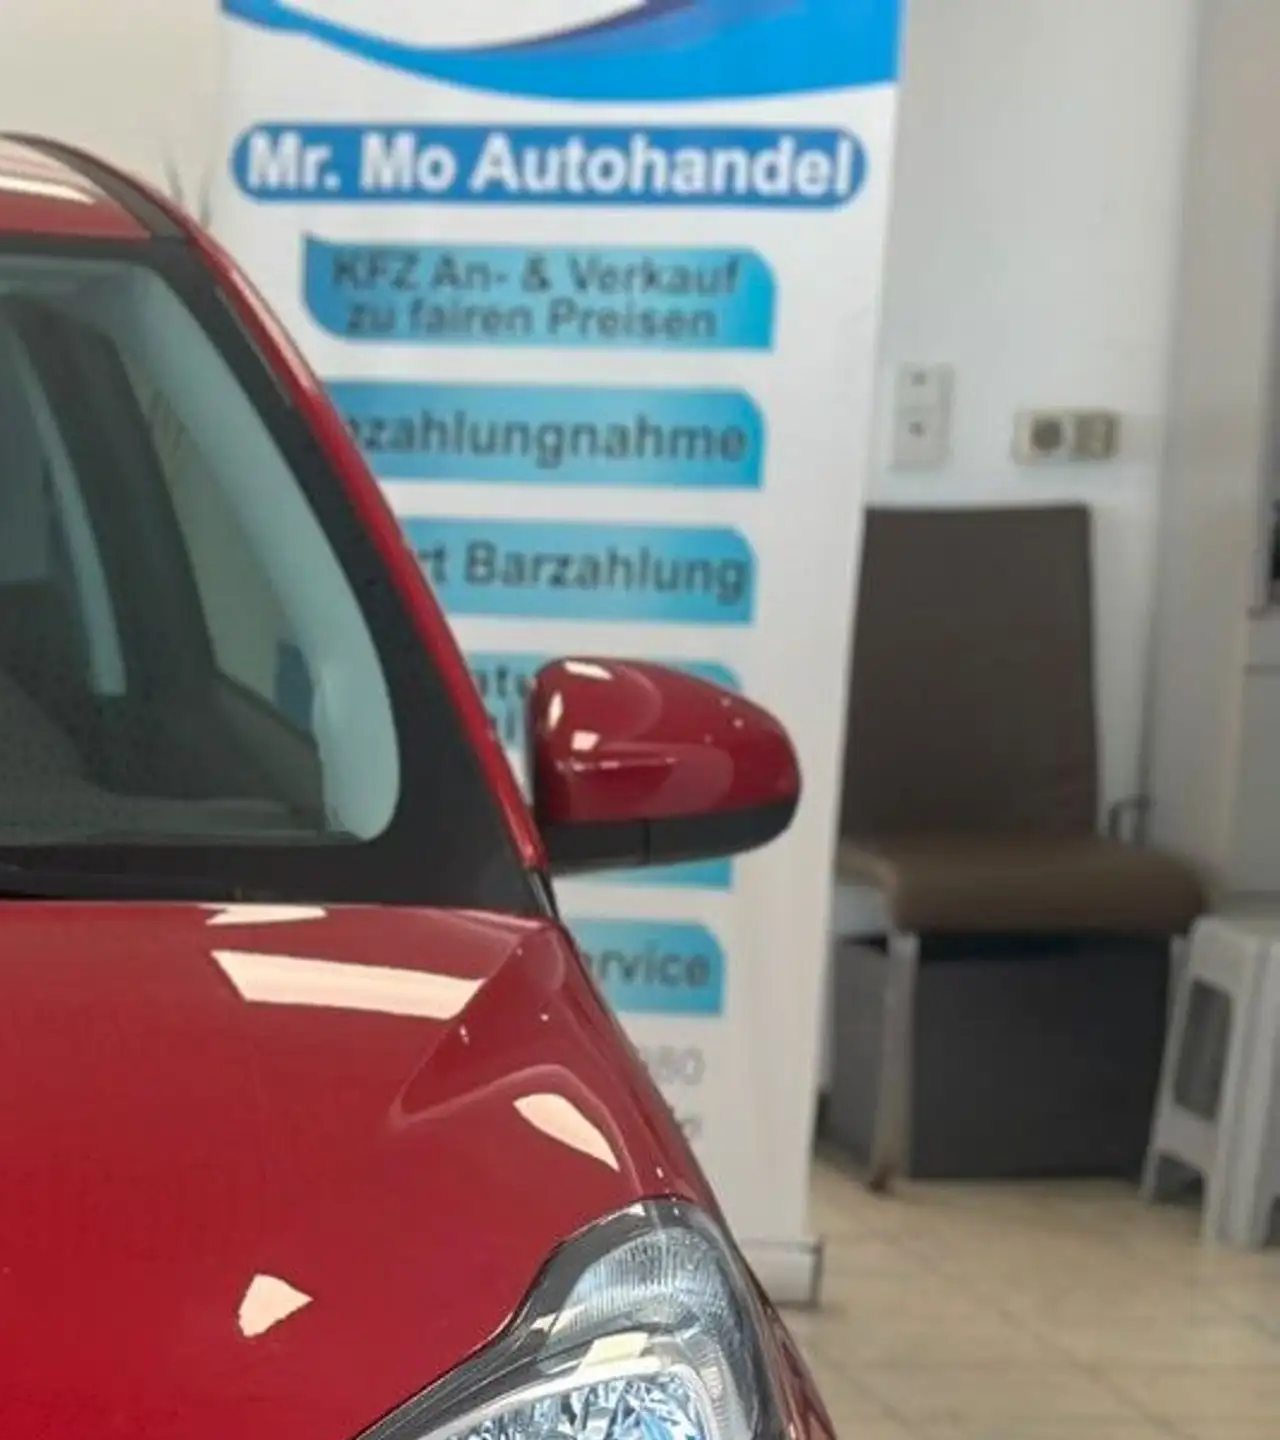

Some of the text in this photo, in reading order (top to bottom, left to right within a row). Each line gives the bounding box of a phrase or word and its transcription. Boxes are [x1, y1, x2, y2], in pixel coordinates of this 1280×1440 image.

[247, 129, 854, 197] Mr. Mo Autohandel
[332, 250, 739, 297] KFZ An- & Verkauf
[347, 297, 717, 341] zu fairen Preisen
[464, 541, 746, 606] Barzahlung
